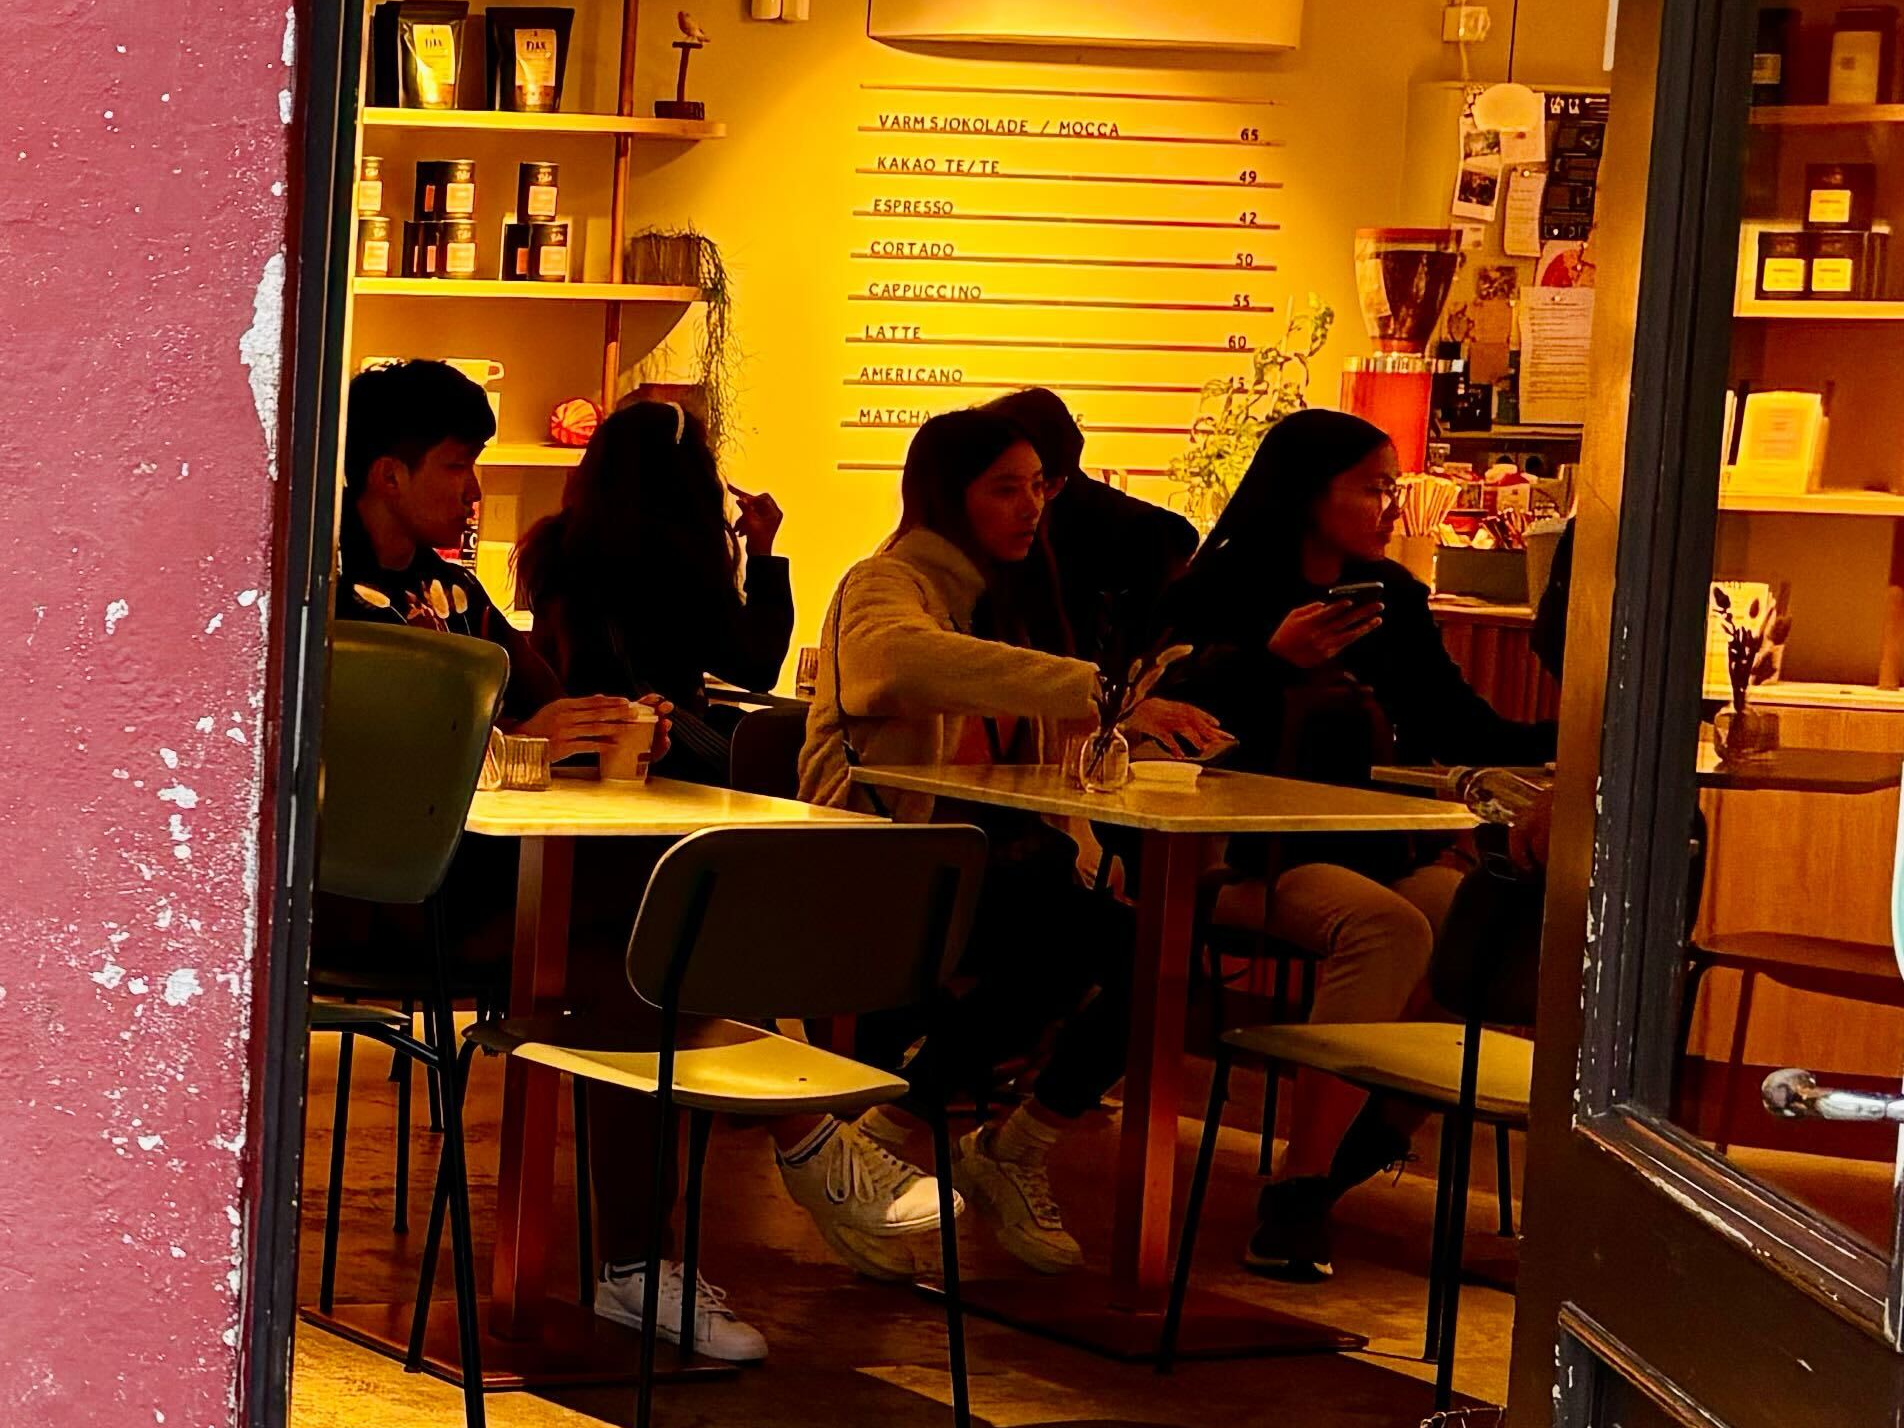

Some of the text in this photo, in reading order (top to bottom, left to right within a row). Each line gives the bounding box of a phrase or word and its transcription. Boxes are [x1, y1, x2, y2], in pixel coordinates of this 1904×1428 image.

[1059, 121, 1120, 137] MOCCA
[1240, 128, 1260, 143] 65
[877, 156, 936, 173] KAKAO
[1238, 170, 1258, 185] 49
[872, 198, 955, 216] ESPRESSO
[1238, 212, 1258, 227] 42
[870, 241, 955, 258] CORTADO
[1235, 253, 1254, 269] 50
[868, 283, 982, 301] CAPPUCCINO
[1233, 295, 1252, 310] 55
[864, 325, 922, 342] LATTE
[1228, 335, 1247, 351] 60
[859, 367, 964, 384] AMERICANO
